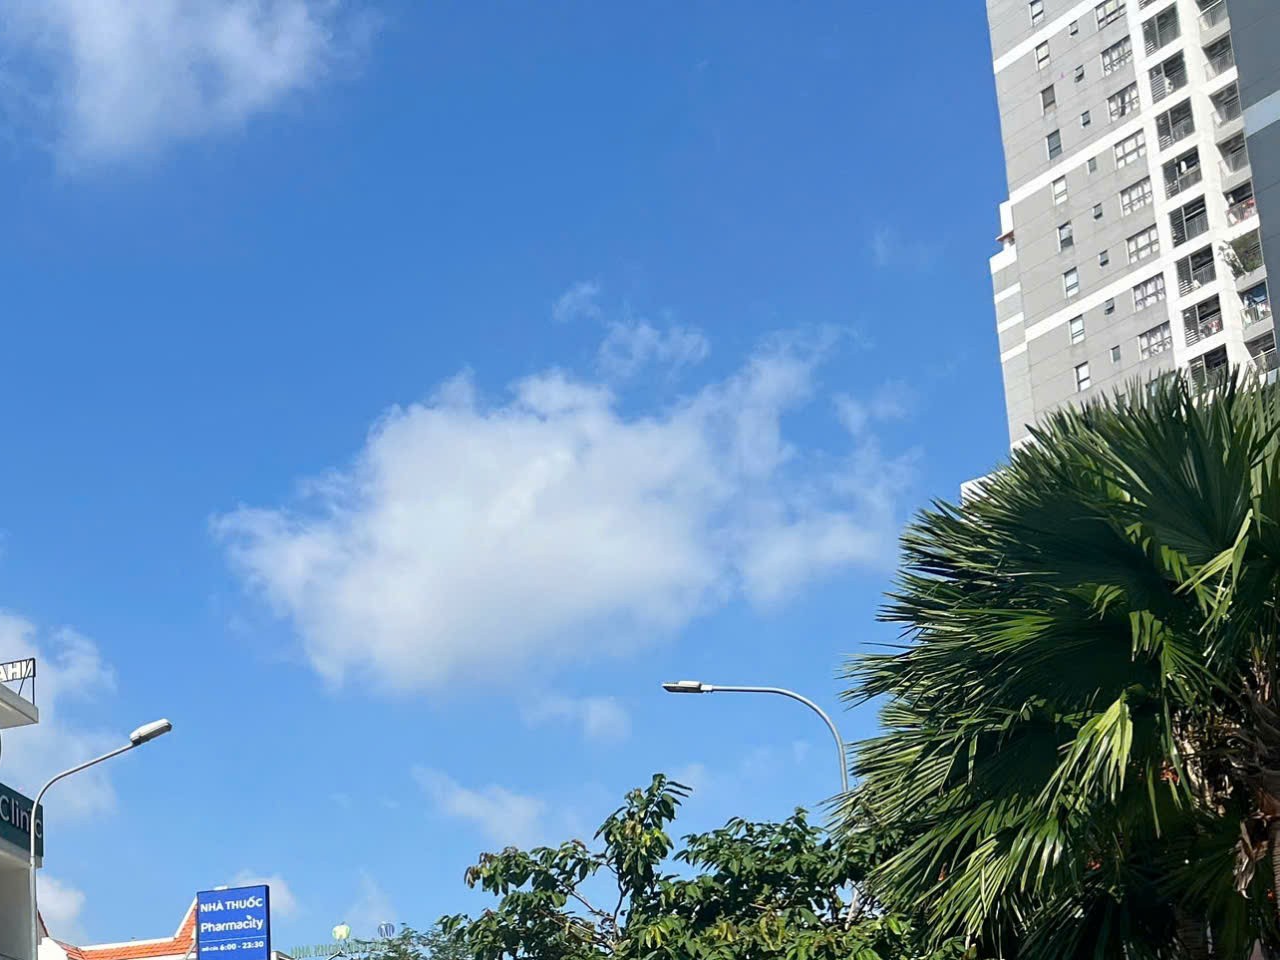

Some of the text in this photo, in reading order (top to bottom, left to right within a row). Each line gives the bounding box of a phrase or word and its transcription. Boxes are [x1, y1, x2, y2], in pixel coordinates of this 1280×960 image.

[200, 895, 263, 913] NHÀ THUỐC
[201, 914, 264, 933] Pharmacity
